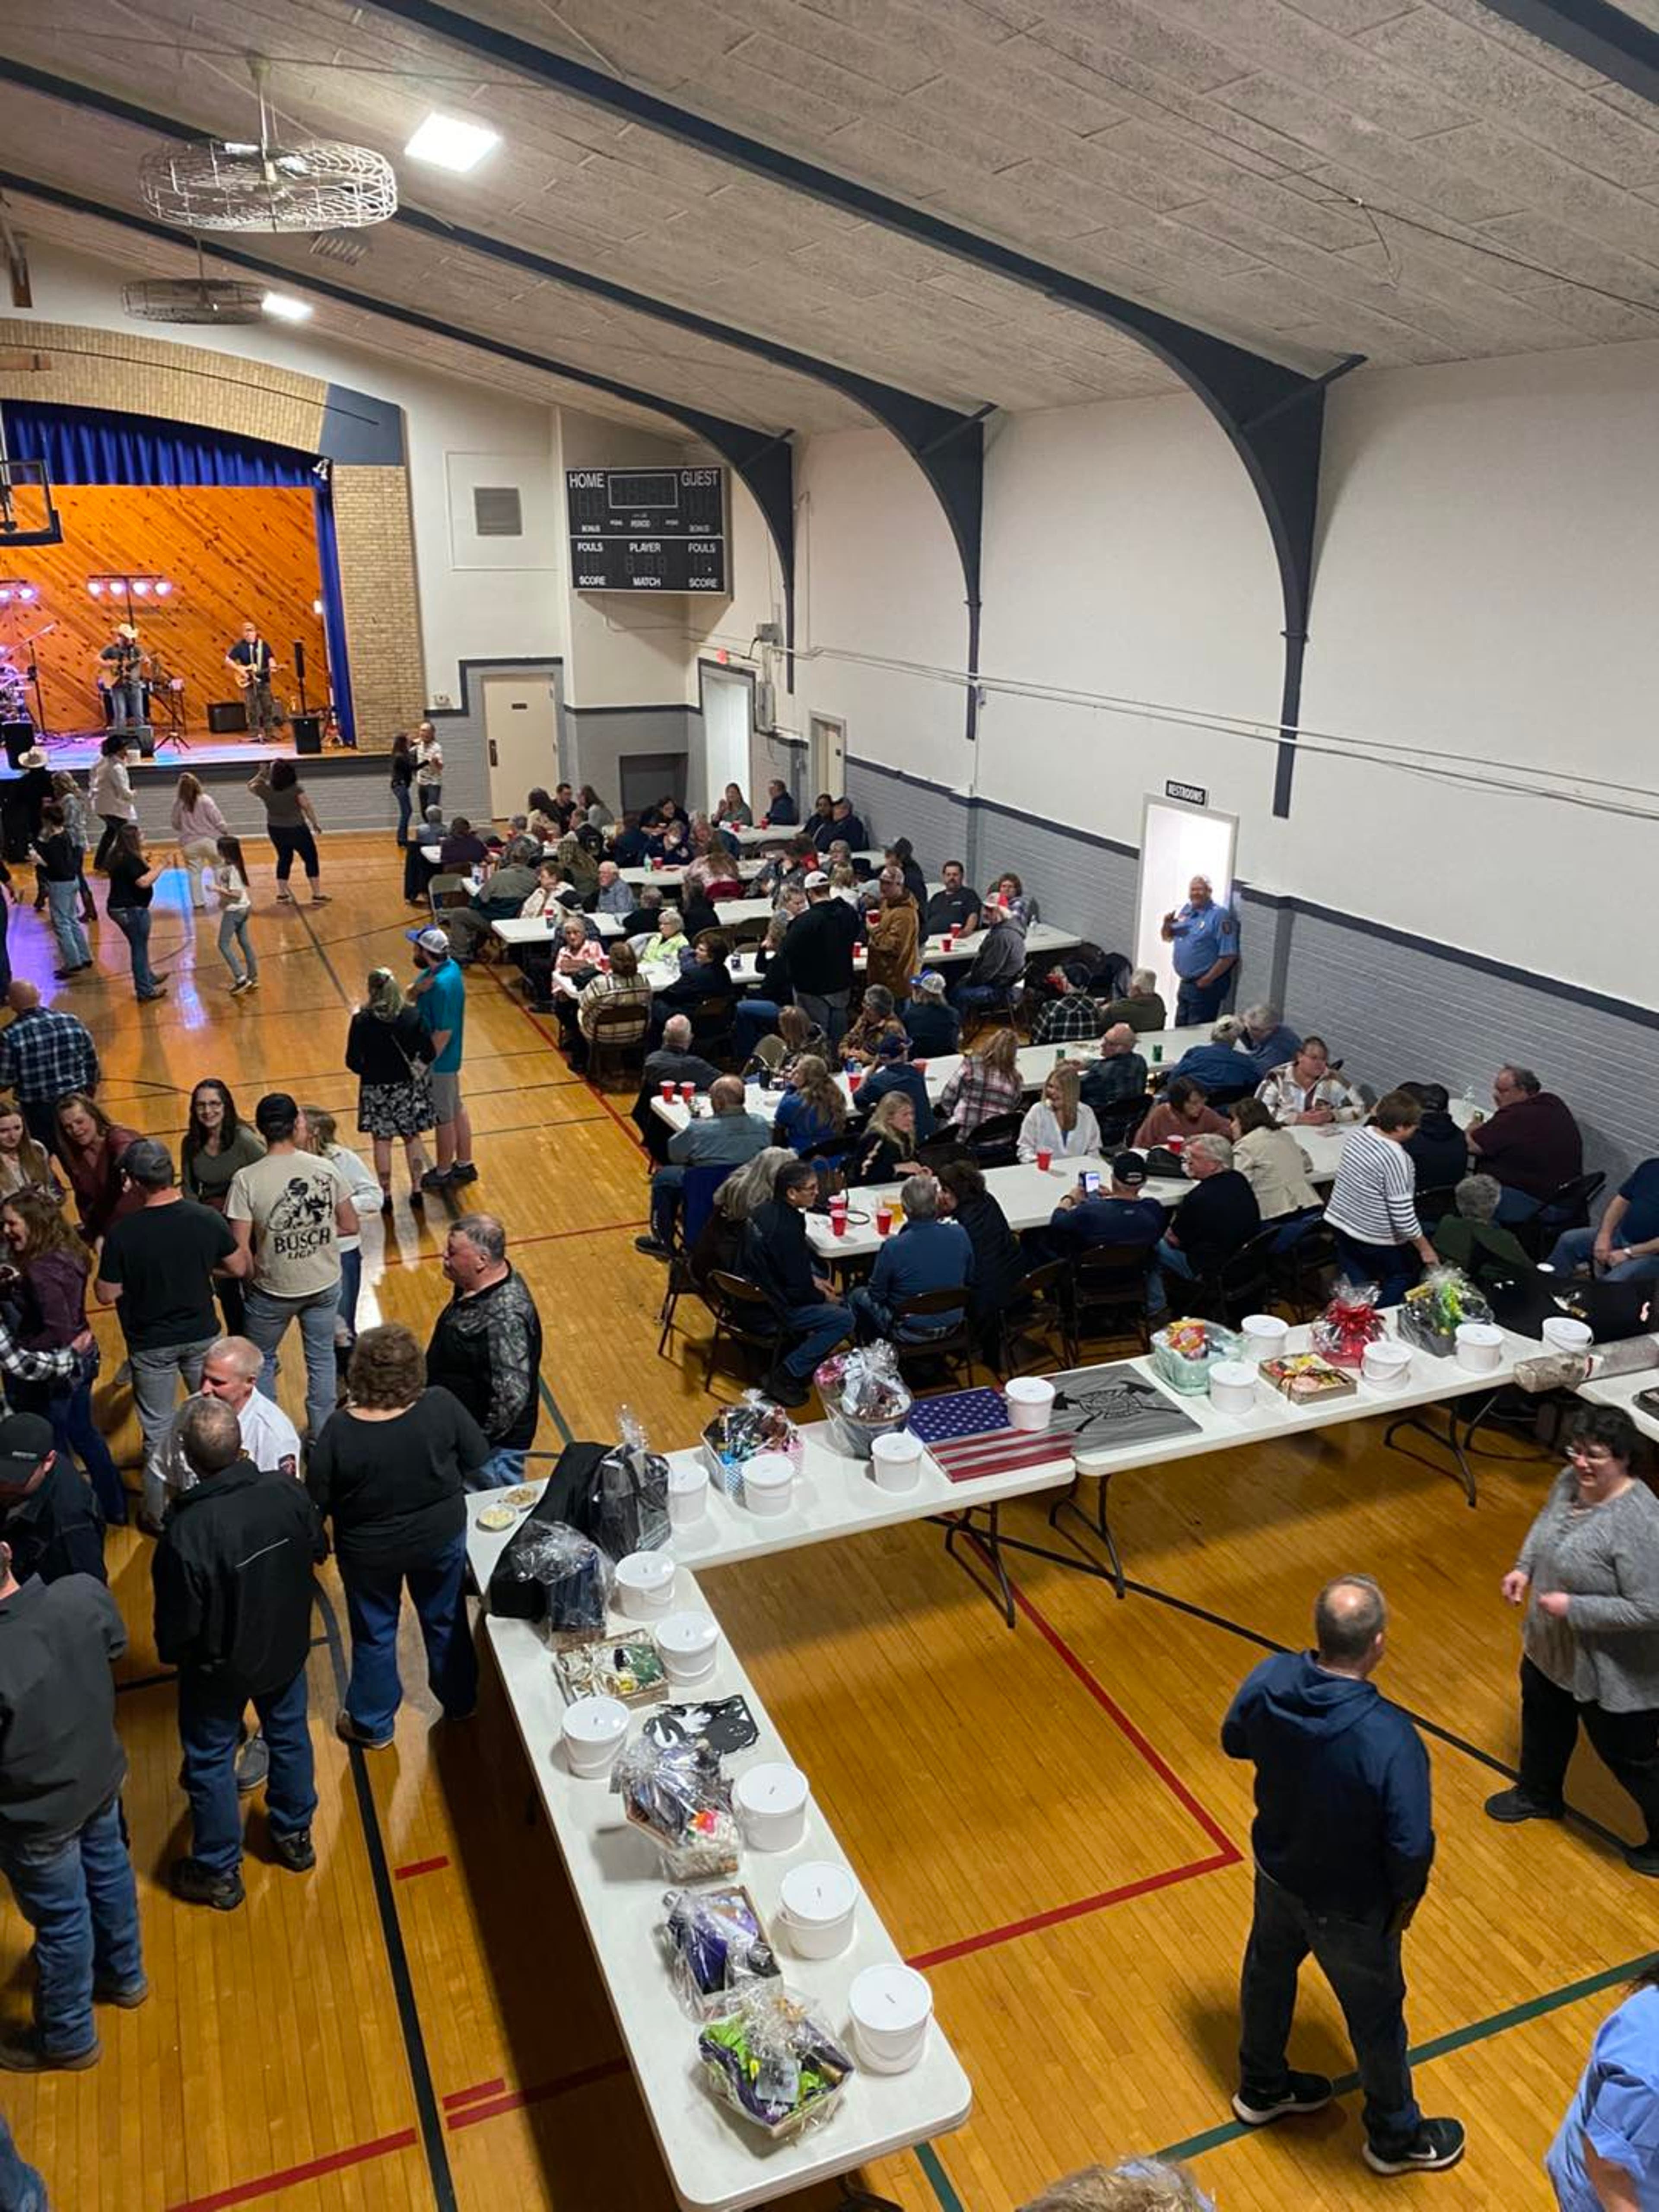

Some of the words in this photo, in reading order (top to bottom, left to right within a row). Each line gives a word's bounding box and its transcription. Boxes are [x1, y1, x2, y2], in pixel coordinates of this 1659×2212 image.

[569, 473, 605, 489] HOME
[680, 471, 718, 487] GUEST
[577, 542, 603, 552] FOULS
[629, 542, 661, 552] PLAYER
[688, 543, 716, 553] FOULS
[578, 576, 606, 586] SCORE
[632, 577, 661, 587] MATCH
[688, 578, 718, 588] SCORE
[274, 1227, 331, 1253] BUSCH
